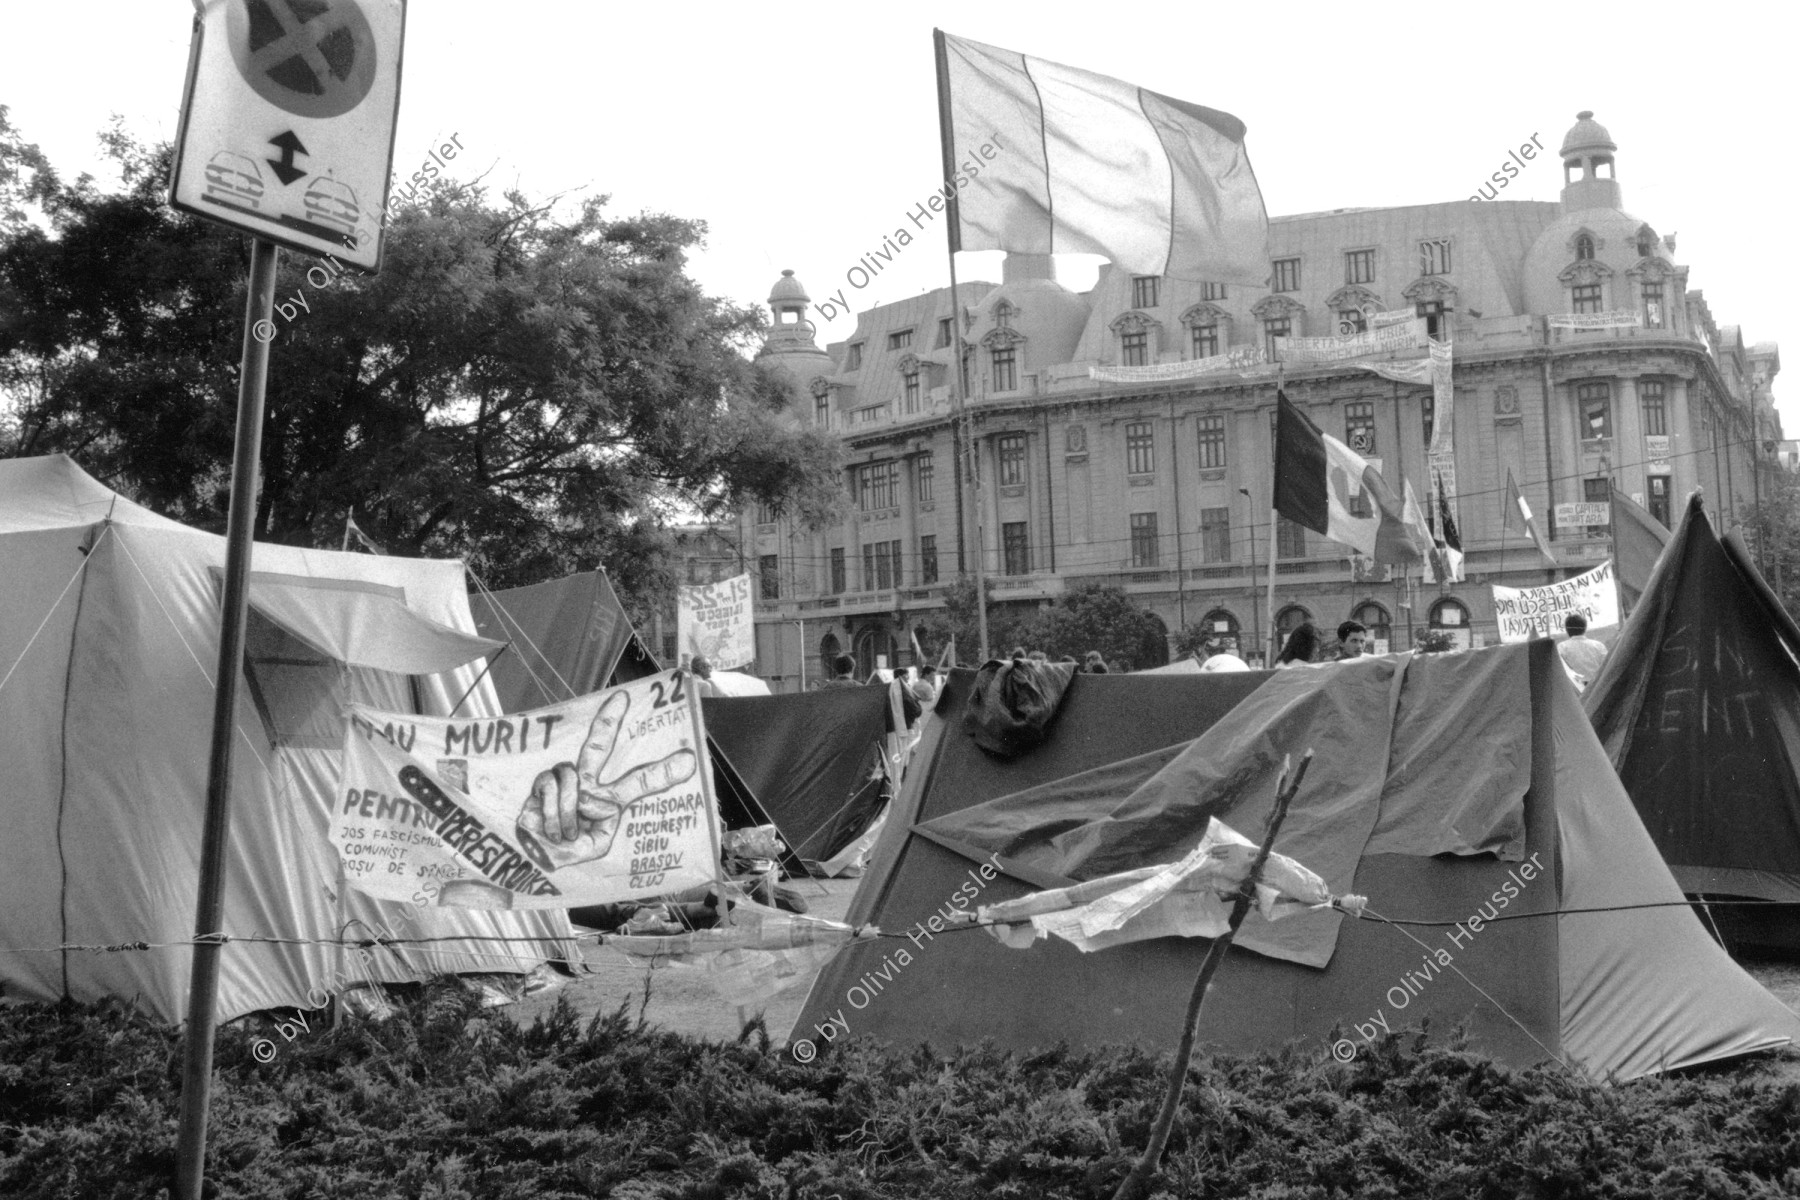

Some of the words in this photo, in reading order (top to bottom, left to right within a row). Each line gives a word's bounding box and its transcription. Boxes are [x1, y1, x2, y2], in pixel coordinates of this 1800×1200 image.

[650, 669, 685, 709] 22
[341, 826, 365, 840] JOS
[388, 861, 406, 875] DE
[629, 873, 665, 889] CLUJ
